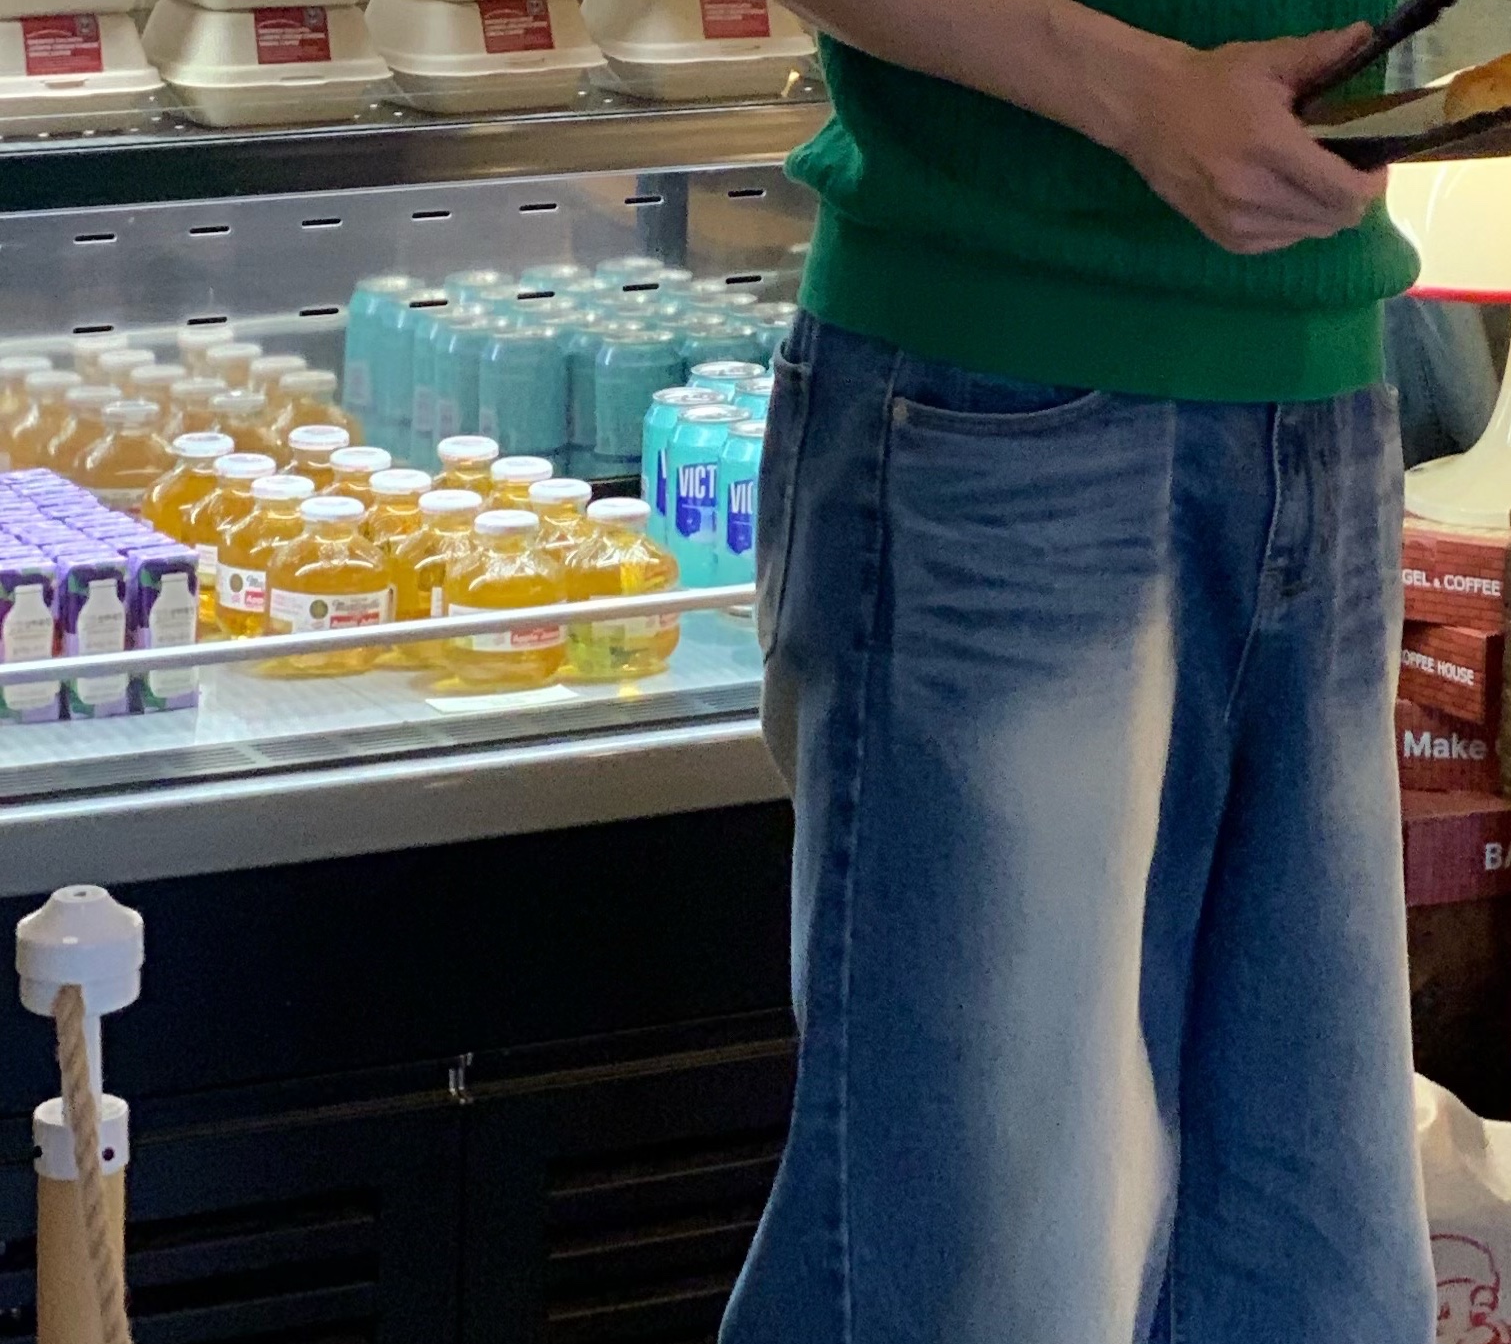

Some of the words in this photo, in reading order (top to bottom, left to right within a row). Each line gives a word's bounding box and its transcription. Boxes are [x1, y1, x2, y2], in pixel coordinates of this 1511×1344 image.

[678, 464, 717, 498] VICT
[1444, 574, 1501, 596] COFFEE
[1437, 660, 1474, 686] HOUSE
[1404, 730, 1486, 759] Make
